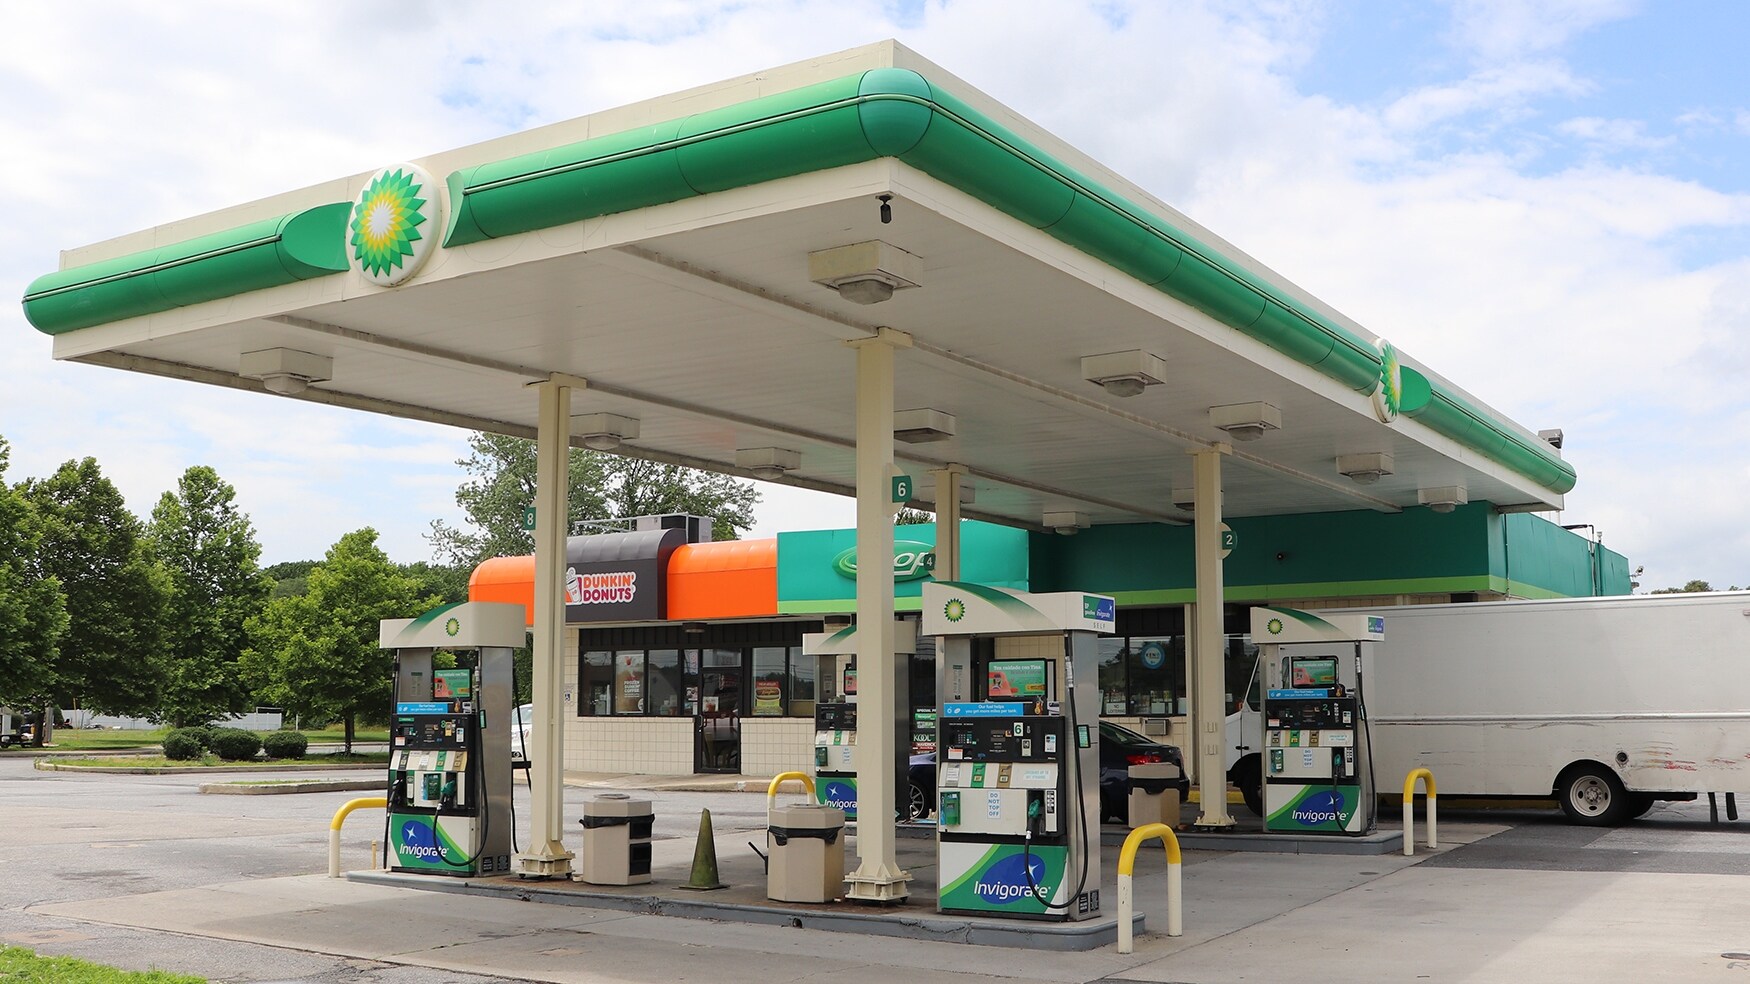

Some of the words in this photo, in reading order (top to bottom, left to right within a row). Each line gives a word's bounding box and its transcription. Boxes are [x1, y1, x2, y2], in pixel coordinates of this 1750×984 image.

[897, 482, 906, 497] 6
[527, 512, 534, 526] 8
[1226, 534, 1233, 545] 2
[926, 557, 932, 567] 4
[583, 574, 635, 589] DUNKIN'
[583, 587, 632, 602] DONUTS
[1322, 703, 1329, 712] 2
[440, 719, 447, 729] 8
[1014, 724, 1022, 735] 6
[913, 733, 932, 742] KOOL
[824, 798, 858, 810] Invigora
[973, 880, 1049, 900] Invigorate
